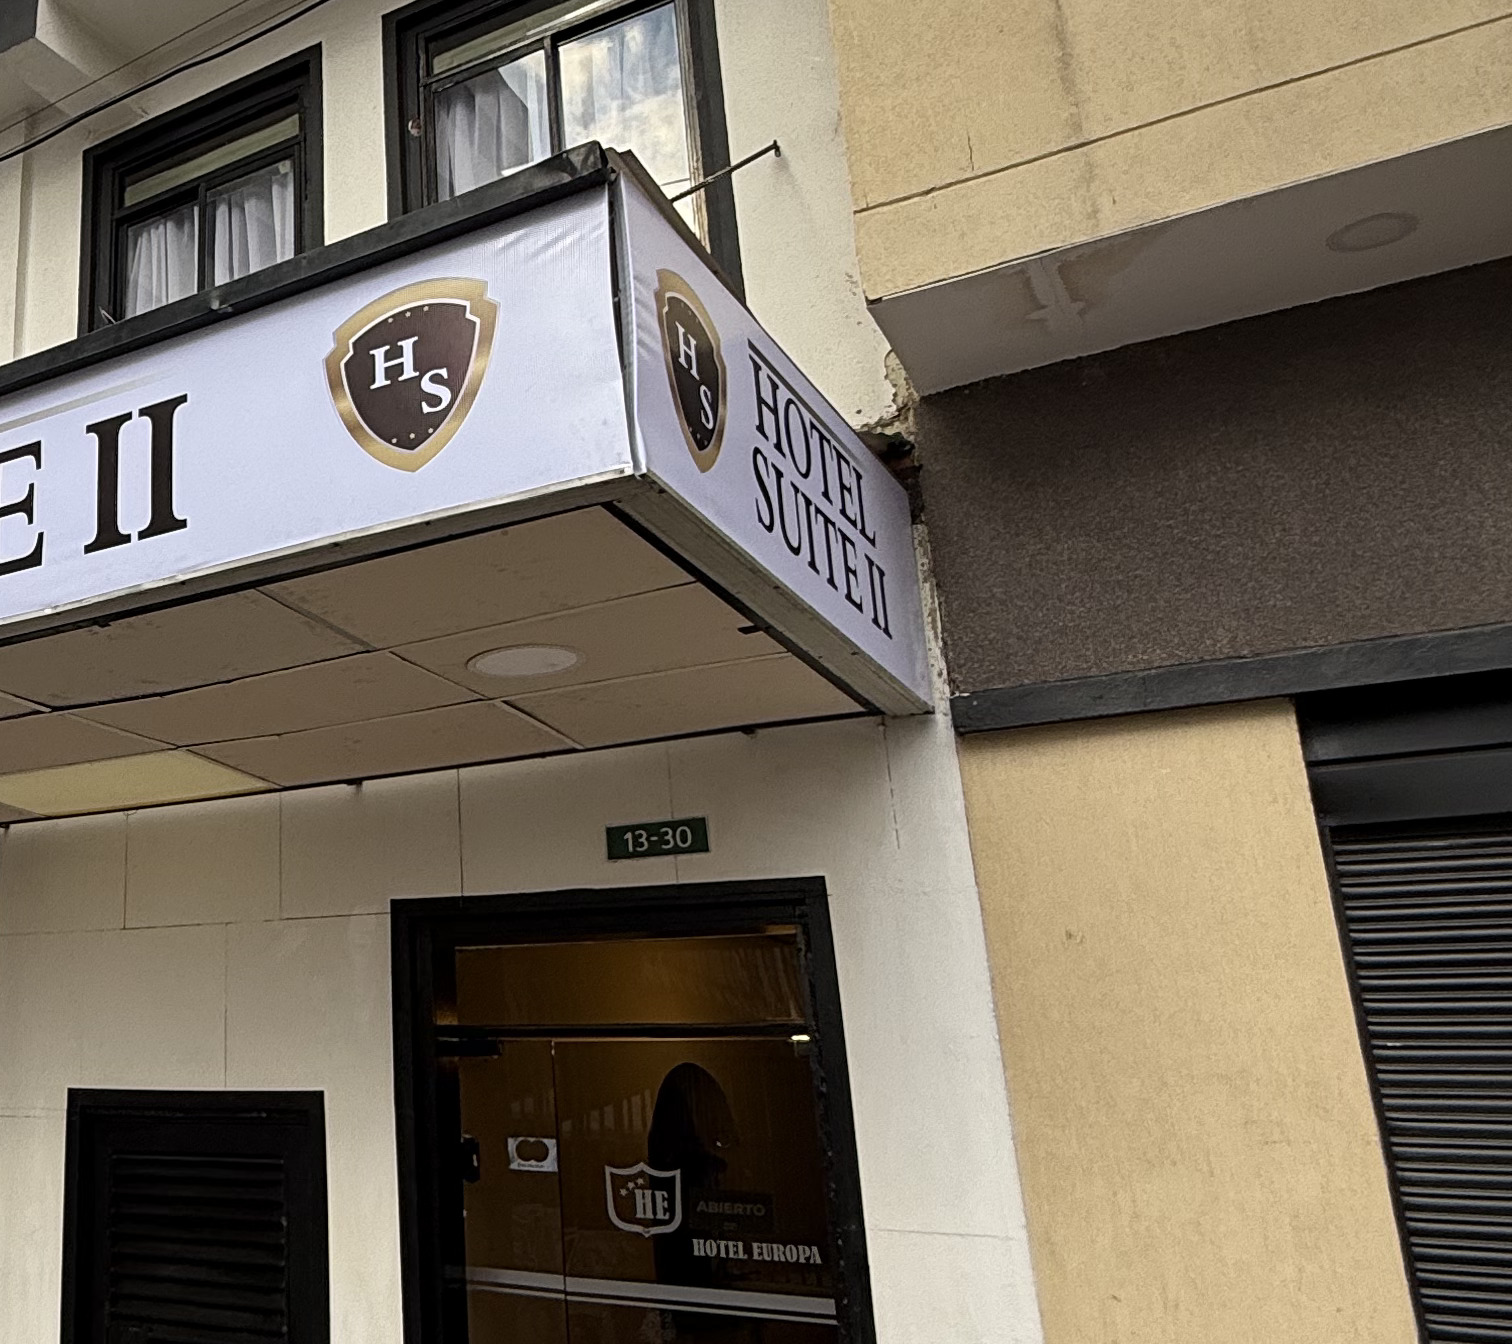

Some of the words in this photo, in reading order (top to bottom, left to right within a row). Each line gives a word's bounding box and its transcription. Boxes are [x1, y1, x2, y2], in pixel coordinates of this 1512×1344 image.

[748, 353, 877, 549] HOTEL
[84, 393, 189, 555] II
[752, 446, 864, 615] SUITE
[863, 551, 893, 641] II
[623, 826, 692, 852] 13-30
[633, 1189, 670, 1220] HE
[696, 1201, 765, 1216] ABIERTO
[692, 1238, 748, 1260] HOTEL
[751, 1242, 822, 1265] EUROPA
